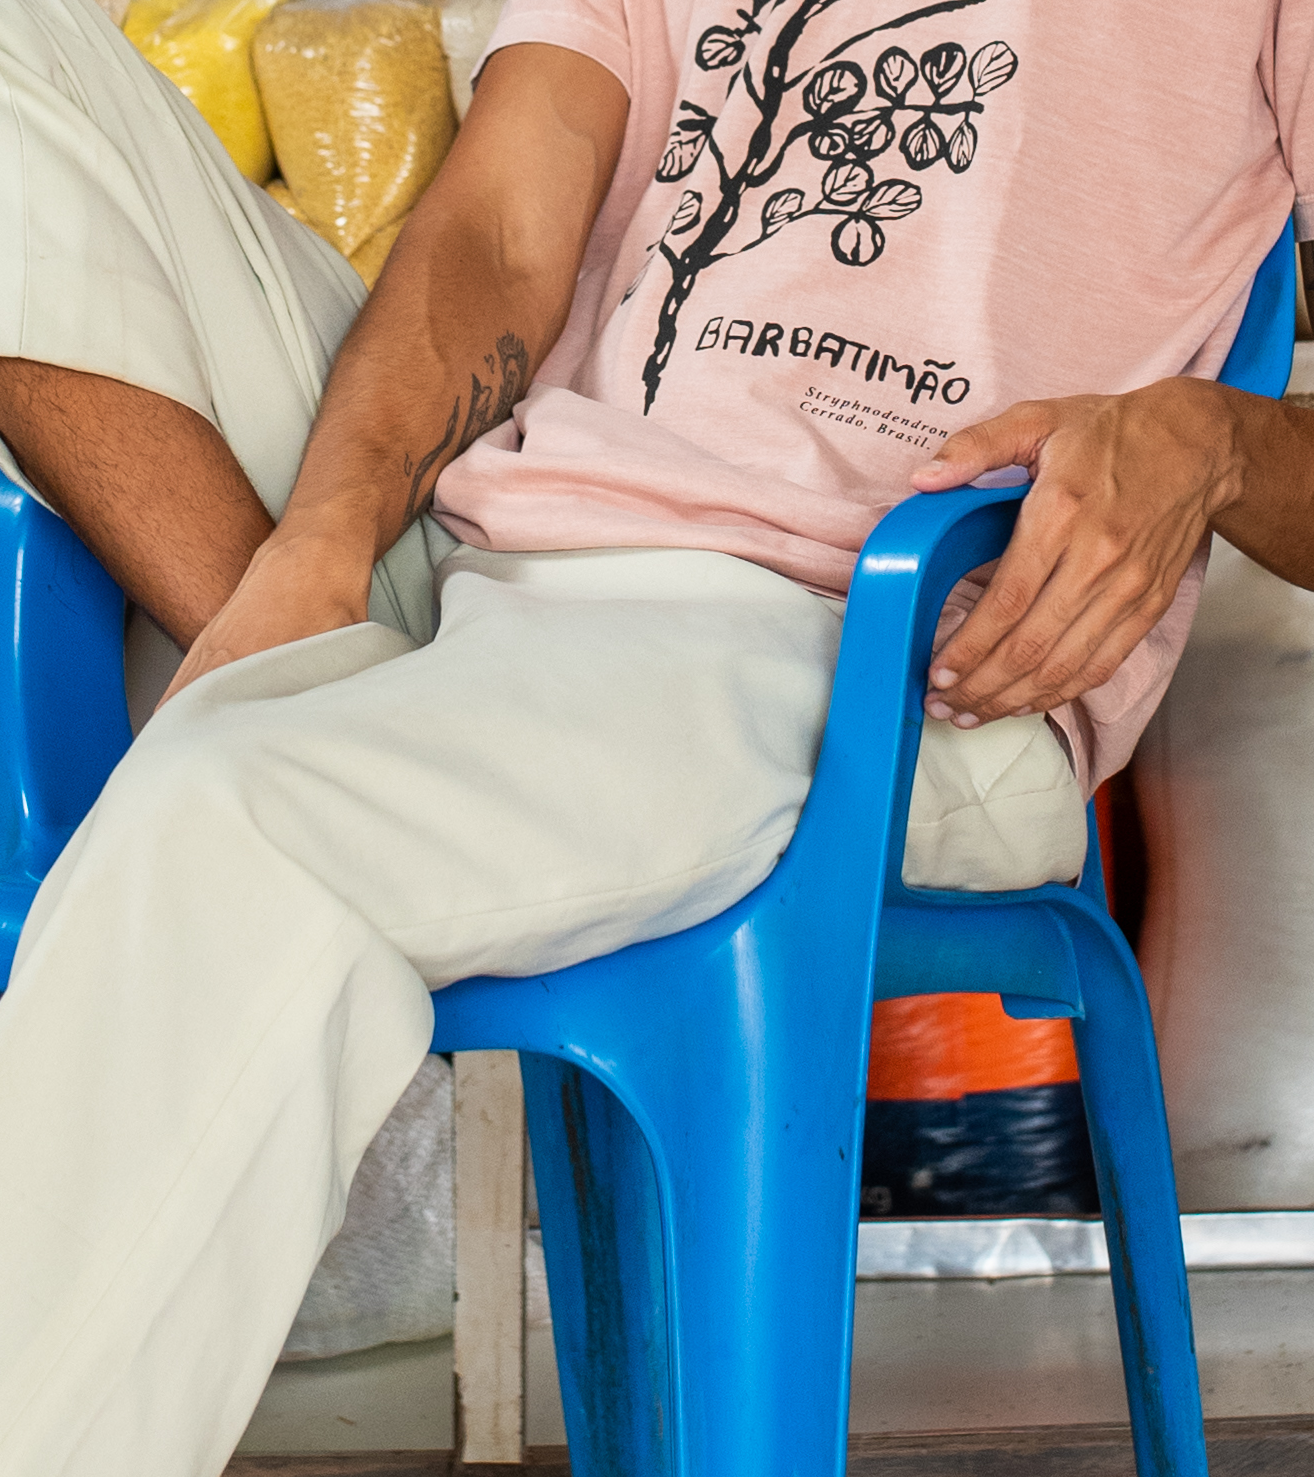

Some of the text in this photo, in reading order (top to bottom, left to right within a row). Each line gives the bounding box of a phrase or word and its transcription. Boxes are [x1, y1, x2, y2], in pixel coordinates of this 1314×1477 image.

[695, 316, 971, 405] BARBATIMÃO
[799, 400, 932, 450] Cerrado, Brasil.
[805, 385, 950, 439] Stryphnodendron
